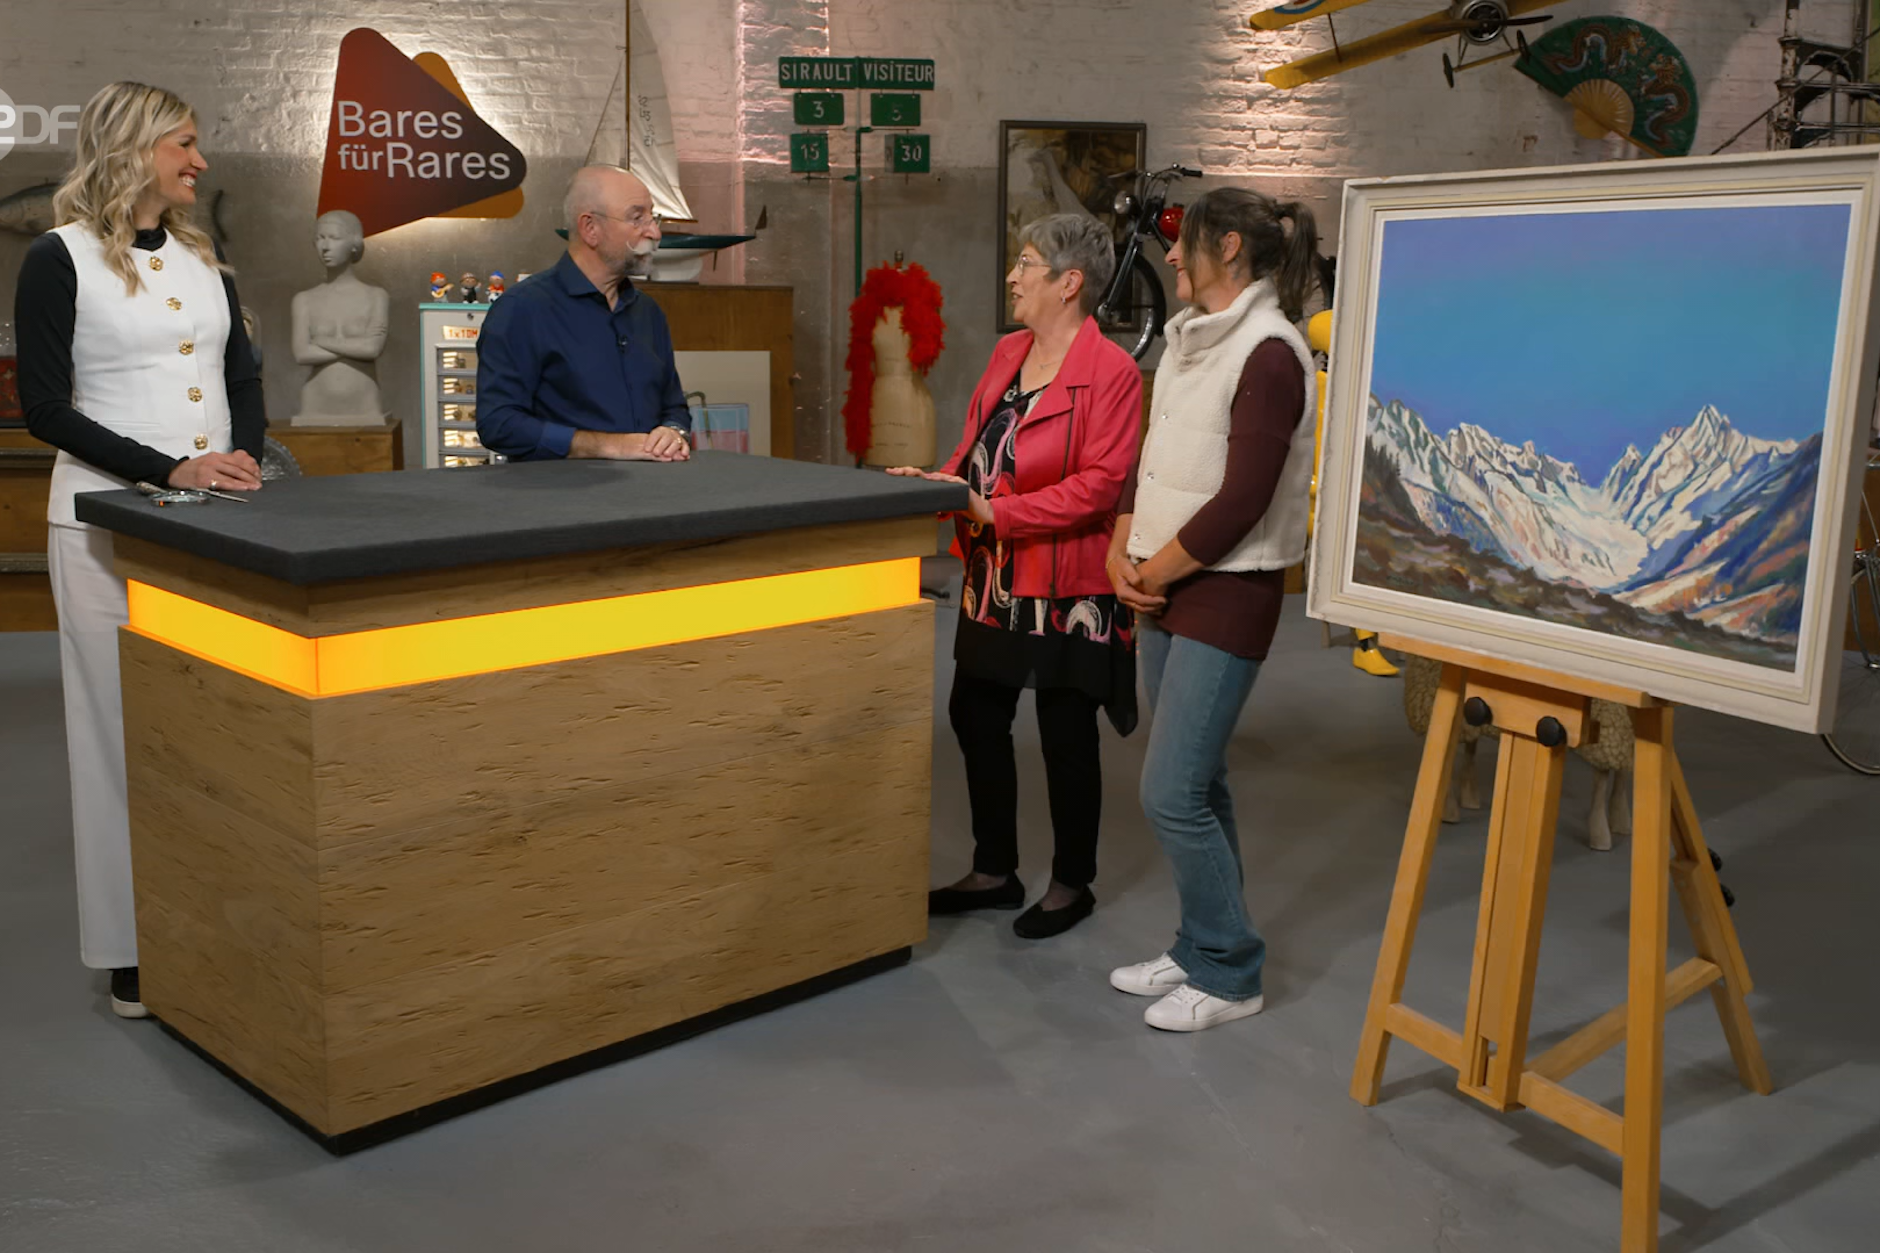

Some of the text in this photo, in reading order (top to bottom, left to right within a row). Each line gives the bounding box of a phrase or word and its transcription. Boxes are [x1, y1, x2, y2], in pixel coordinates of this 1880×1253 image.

[781, 63, 852, 81] SIRAULT
[813, 101, 824, 118] 3
[337, 100, 463, 139] Bares
[337, 141, 511, 180] für Rares
[801, 143, 819, 160] 15
[901, 144, 922, 162] 30
